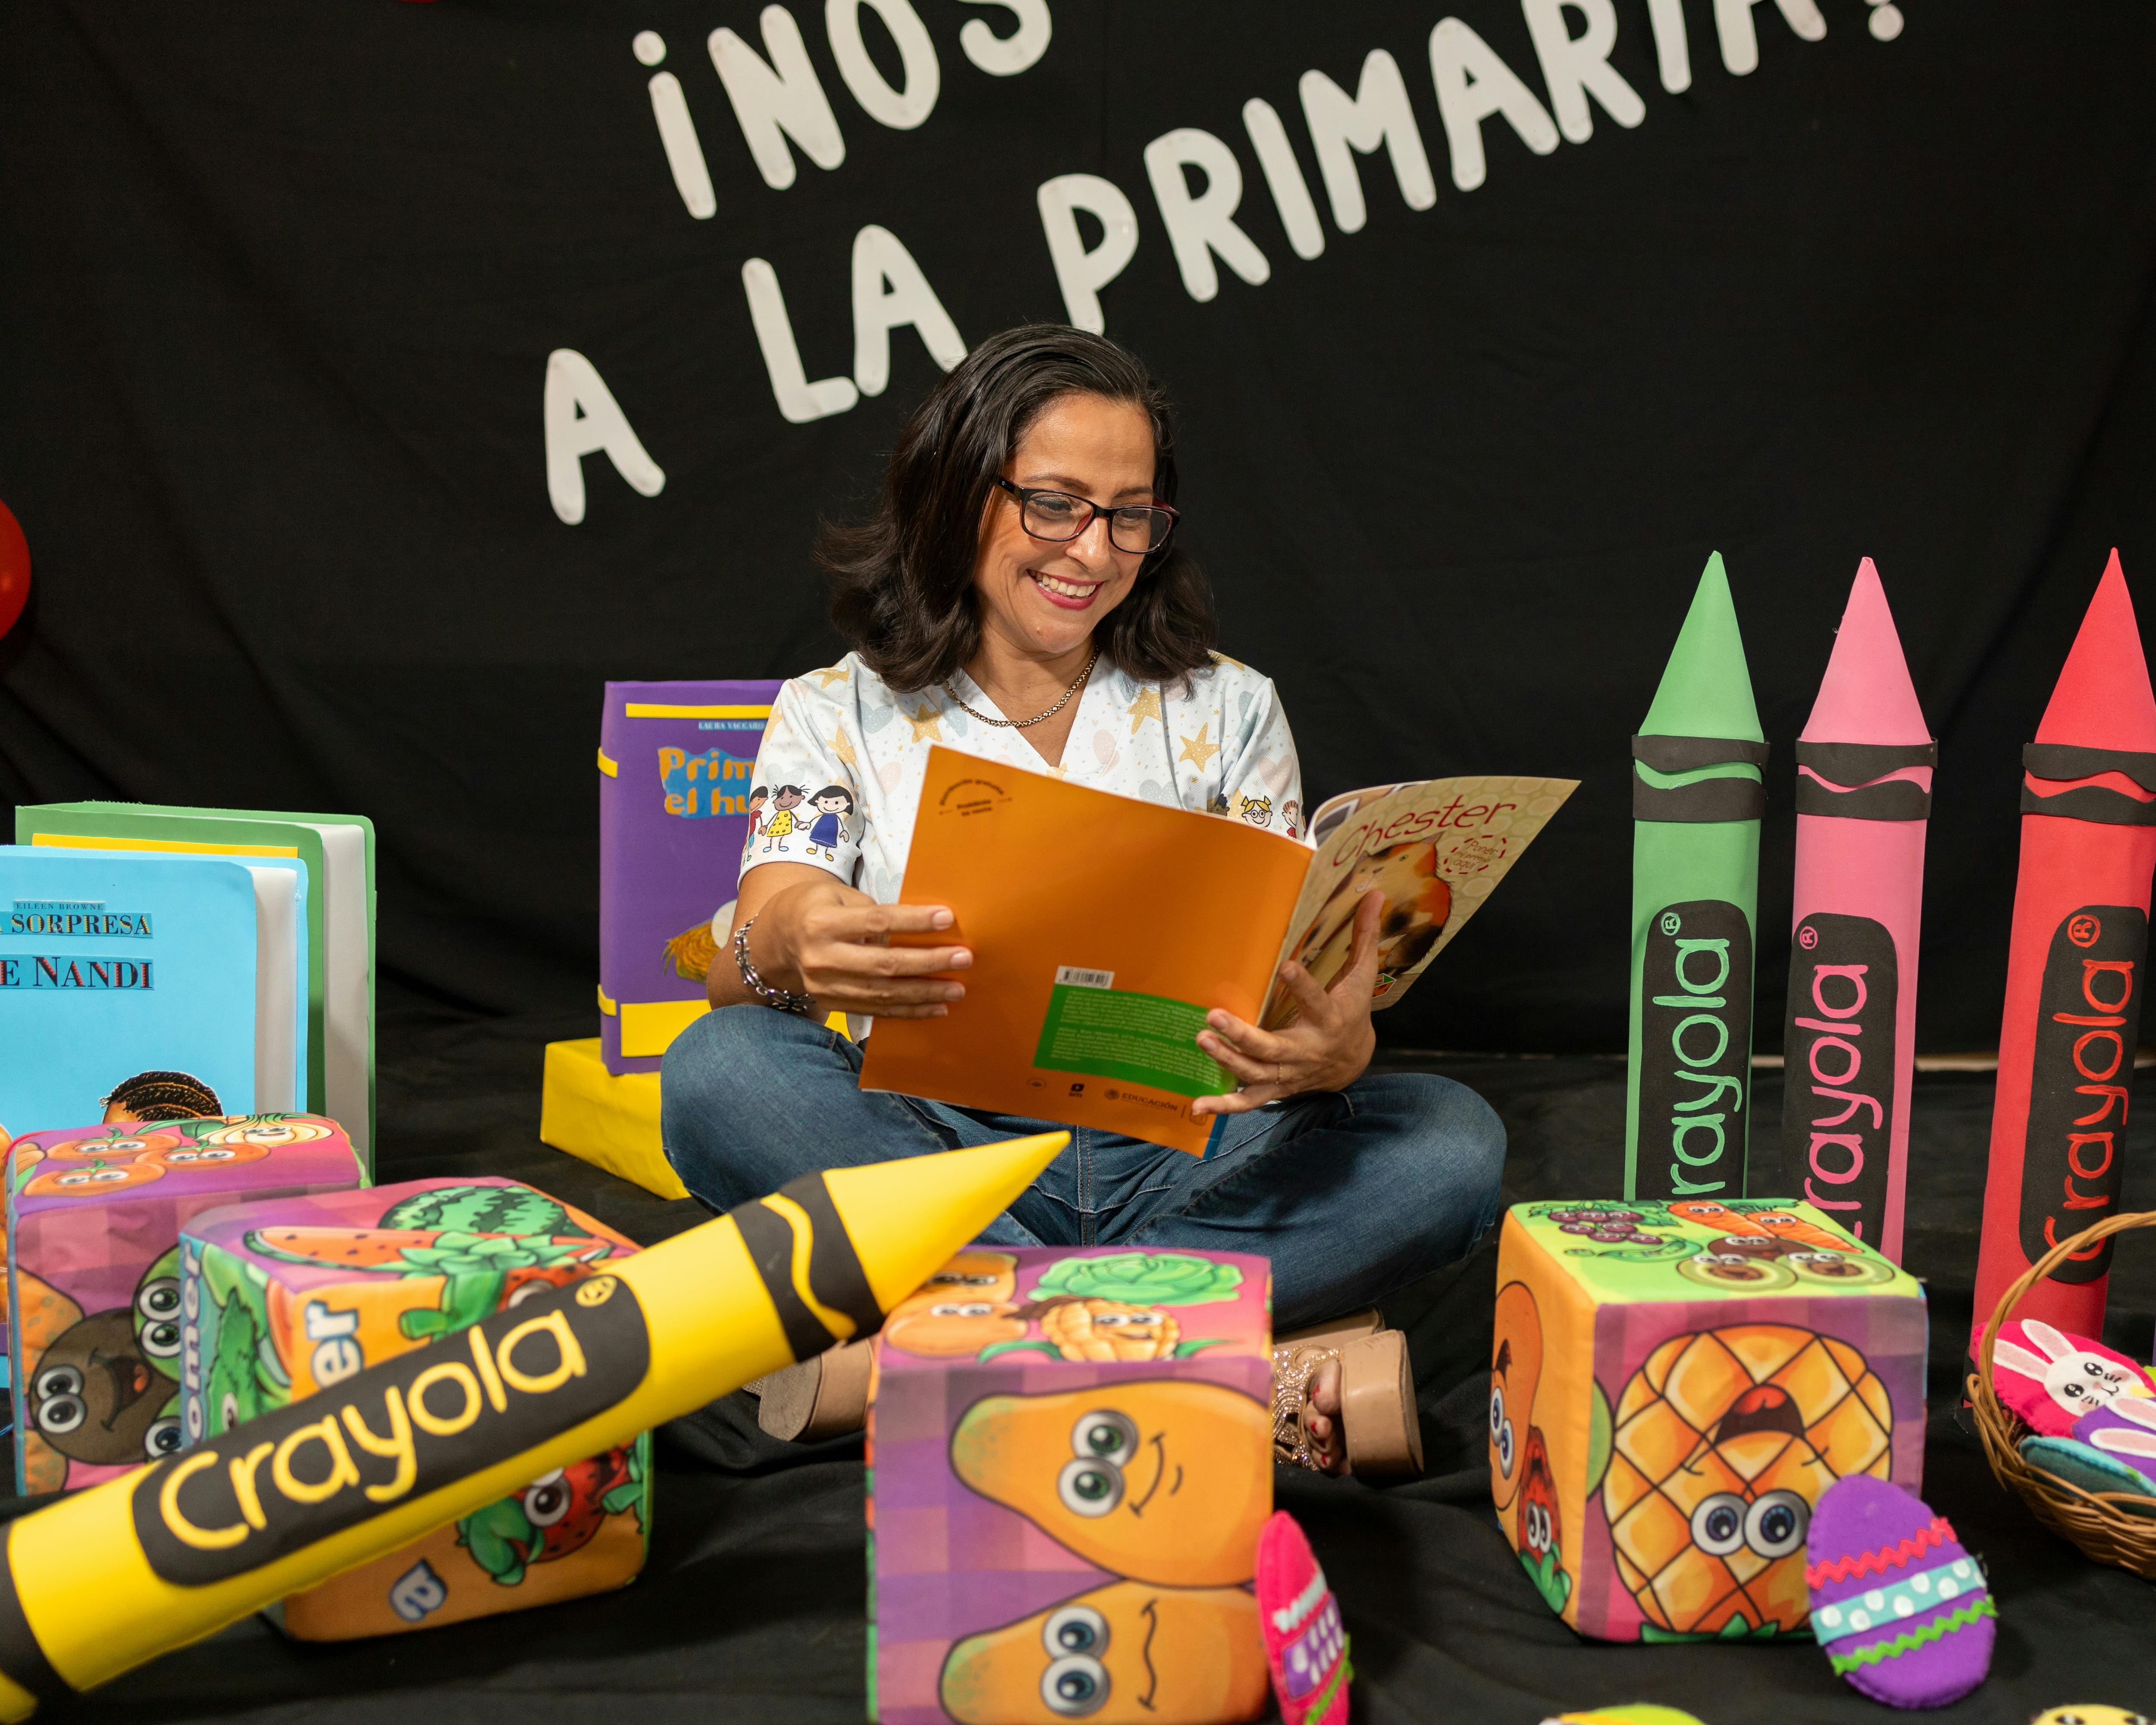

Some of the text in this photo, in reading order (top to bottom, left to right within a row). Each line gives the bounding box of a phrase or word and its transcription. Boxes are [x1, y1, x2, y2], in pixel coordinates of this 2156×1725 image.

[544, 0, 1904, 524] A LA PRIMARI
[658, 747, 756, 781] Prim
[664, 787, 749, 815] el hu
[1333, 794, 1517, 867] Chester
[1466, 841, 1498, 855] Poner
[11, 913, 152, 935] SORPRESA
[0, 956, 153, 988] E NANDI
[1652, 938, 1742, 1195] rayola
[1795, 964, 1883, 1240] rayola
[184, 1239, 203, 1442] omer
[159, 1309, 588, 1551] Crayola
